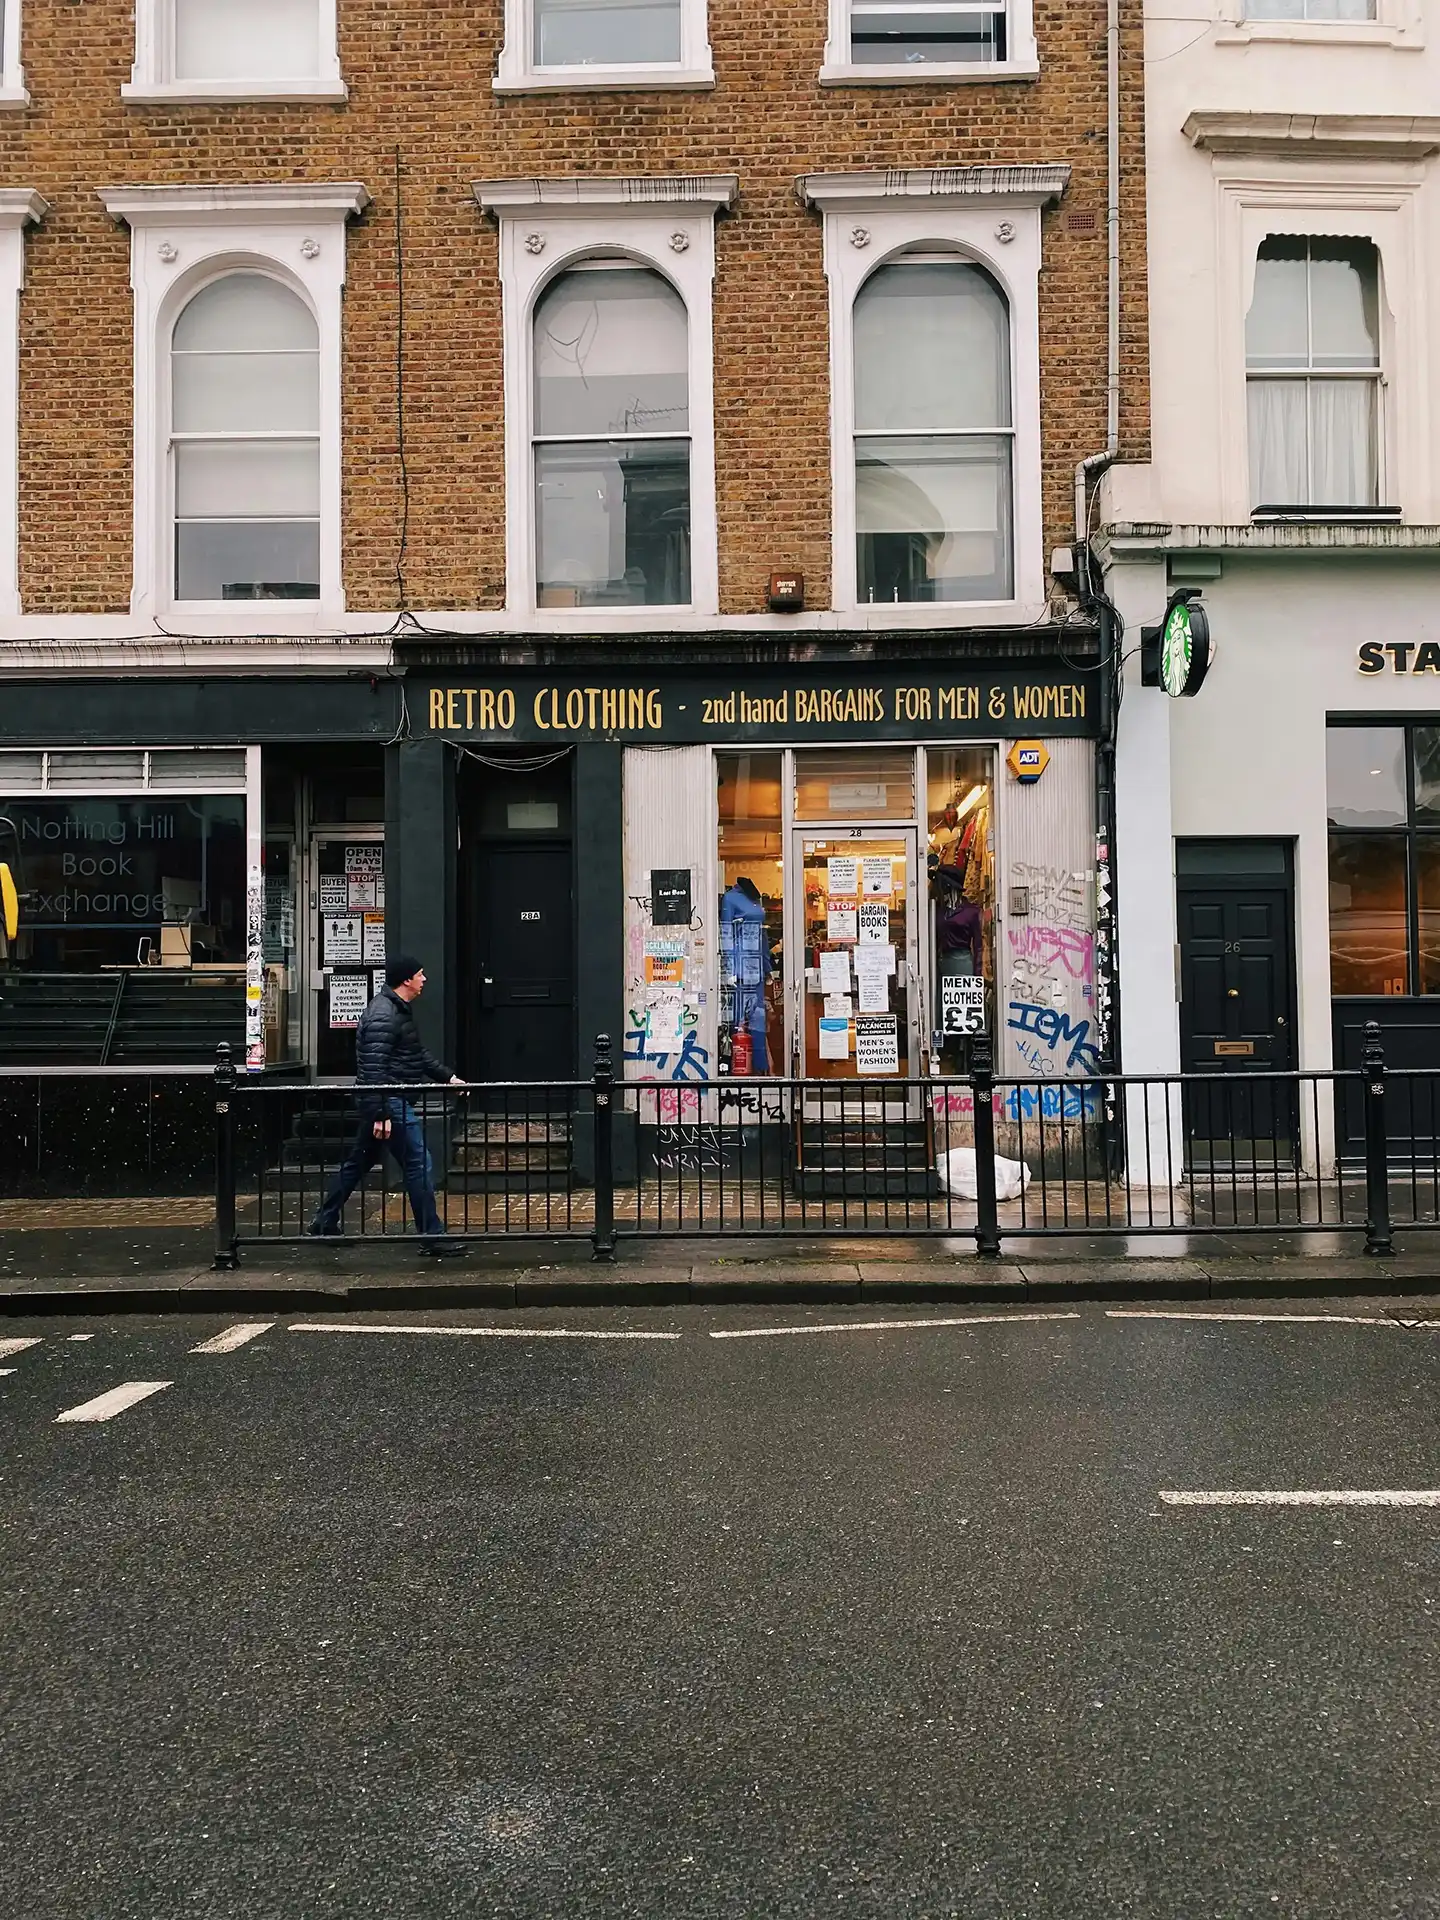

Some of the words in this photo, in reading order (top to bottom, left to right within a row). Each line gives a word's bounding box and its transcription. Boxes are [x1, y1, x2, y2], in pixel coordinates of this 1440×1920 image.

[1358, 641, 1440, 675] STA
[429, 688, 516, 730] RETRO
[534, 688, 662, 730] CLOTHING
[702, 691, 735, 723] 2nd
[740, 690, 788, 723] hand
[795, 688, 885, 722] BARGAINS
[895, 687, 932, 721] FOR
[938, 686, 979, 720] MEN
[988, 686, 1006, 719] &
[1013, 685, 1085, 718] WOMEN
[1019, 752, 1039, 763] ADT
[22, 816, 126, 845] Notting
[137, 815, 174, 838] Hill
[849, 829, 862, 837] 28
[346, 848, 381, 857] OPEN
[62, 852, 134, 876] Book
[321, 878, 346, 886] BUYER
[829, 902, 856, 910] STOP
[861, 906, 887, 916] BARGAIN
[522, 912, 539, 920] 28A
[861, 917, 887, 927] BOOKS
[1225, 942, 1240, 953] 26
[943, 977, 983, 988] MEN'S
[943, 992, 983, 1004] CLOTHES
[944, 1006, 984, 1032] £5
[858, 1047, 896, 1056] WOMEN'S
[859, 1057, 896, 1065] FASHION
